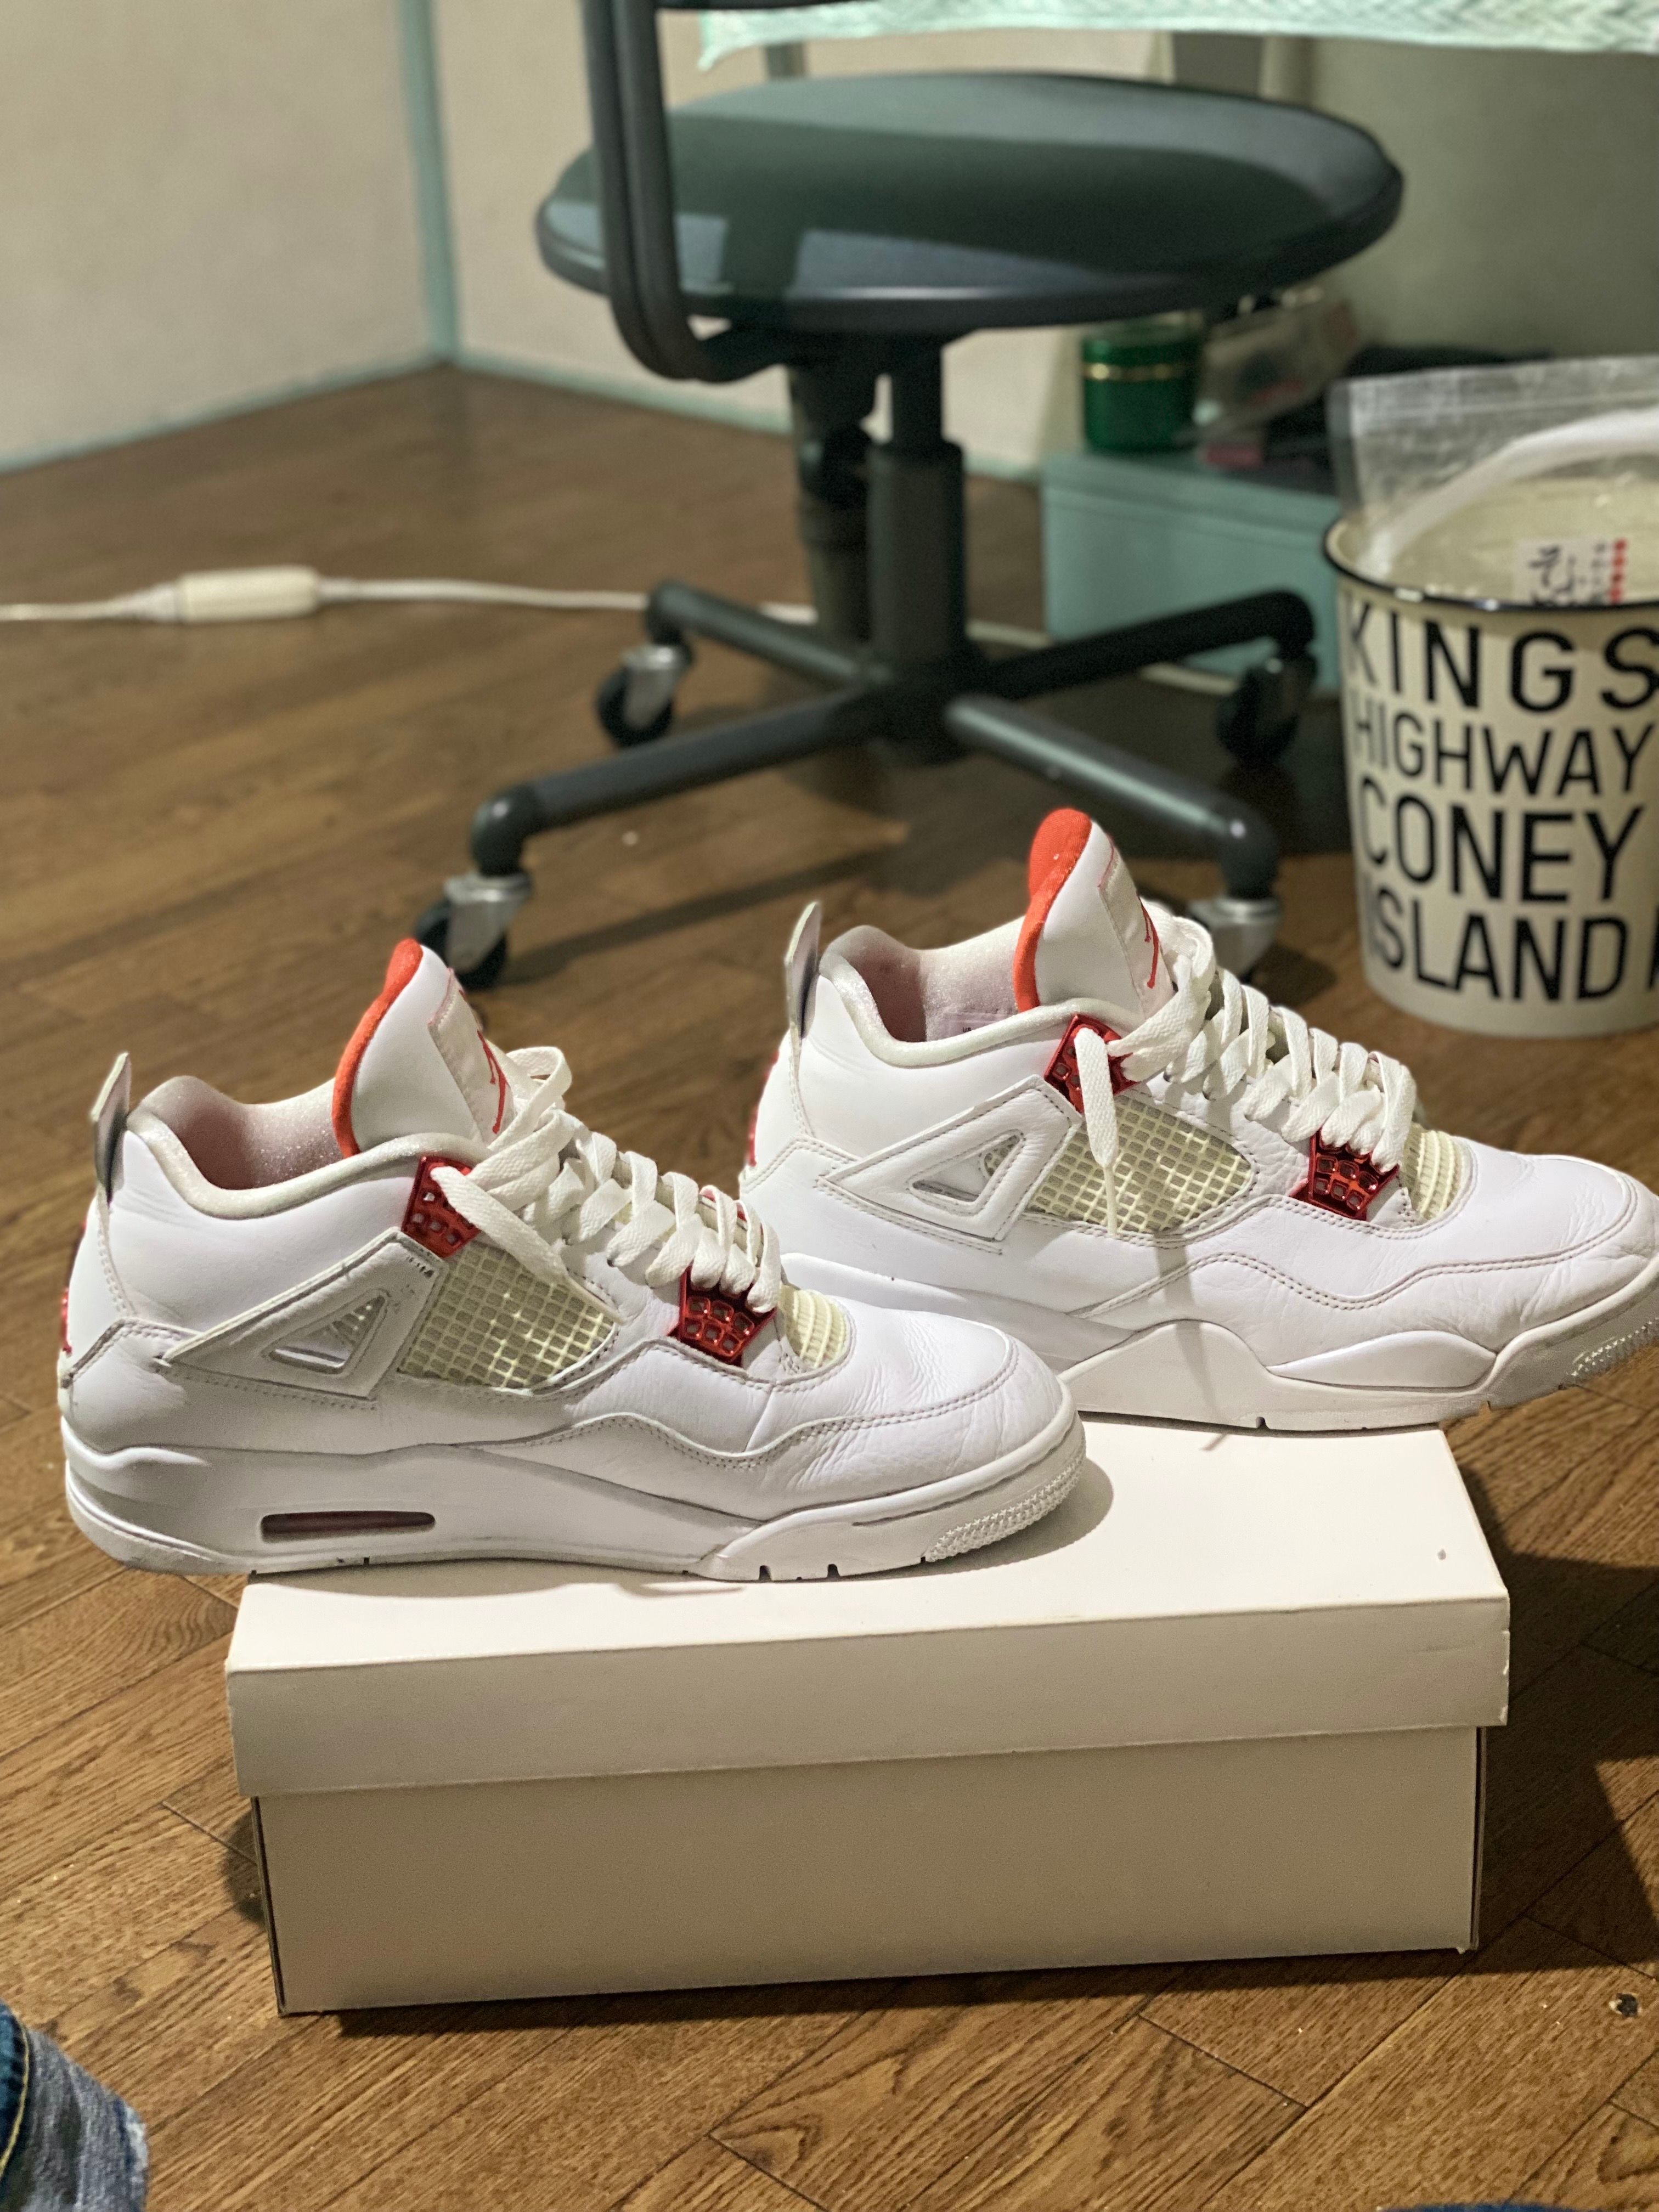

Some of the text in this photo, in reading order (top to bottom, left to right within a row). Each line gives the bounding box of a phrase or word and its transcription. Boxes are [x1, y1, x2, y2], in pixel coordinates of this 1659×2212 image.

[1345, 587, 1659, 712] KINGS
[1350, 689, 1655, 797] HIGHWAY
[1359, 776, 1644, 902] CONEY
[1364, 871, 1628, 1002] ISLAND
